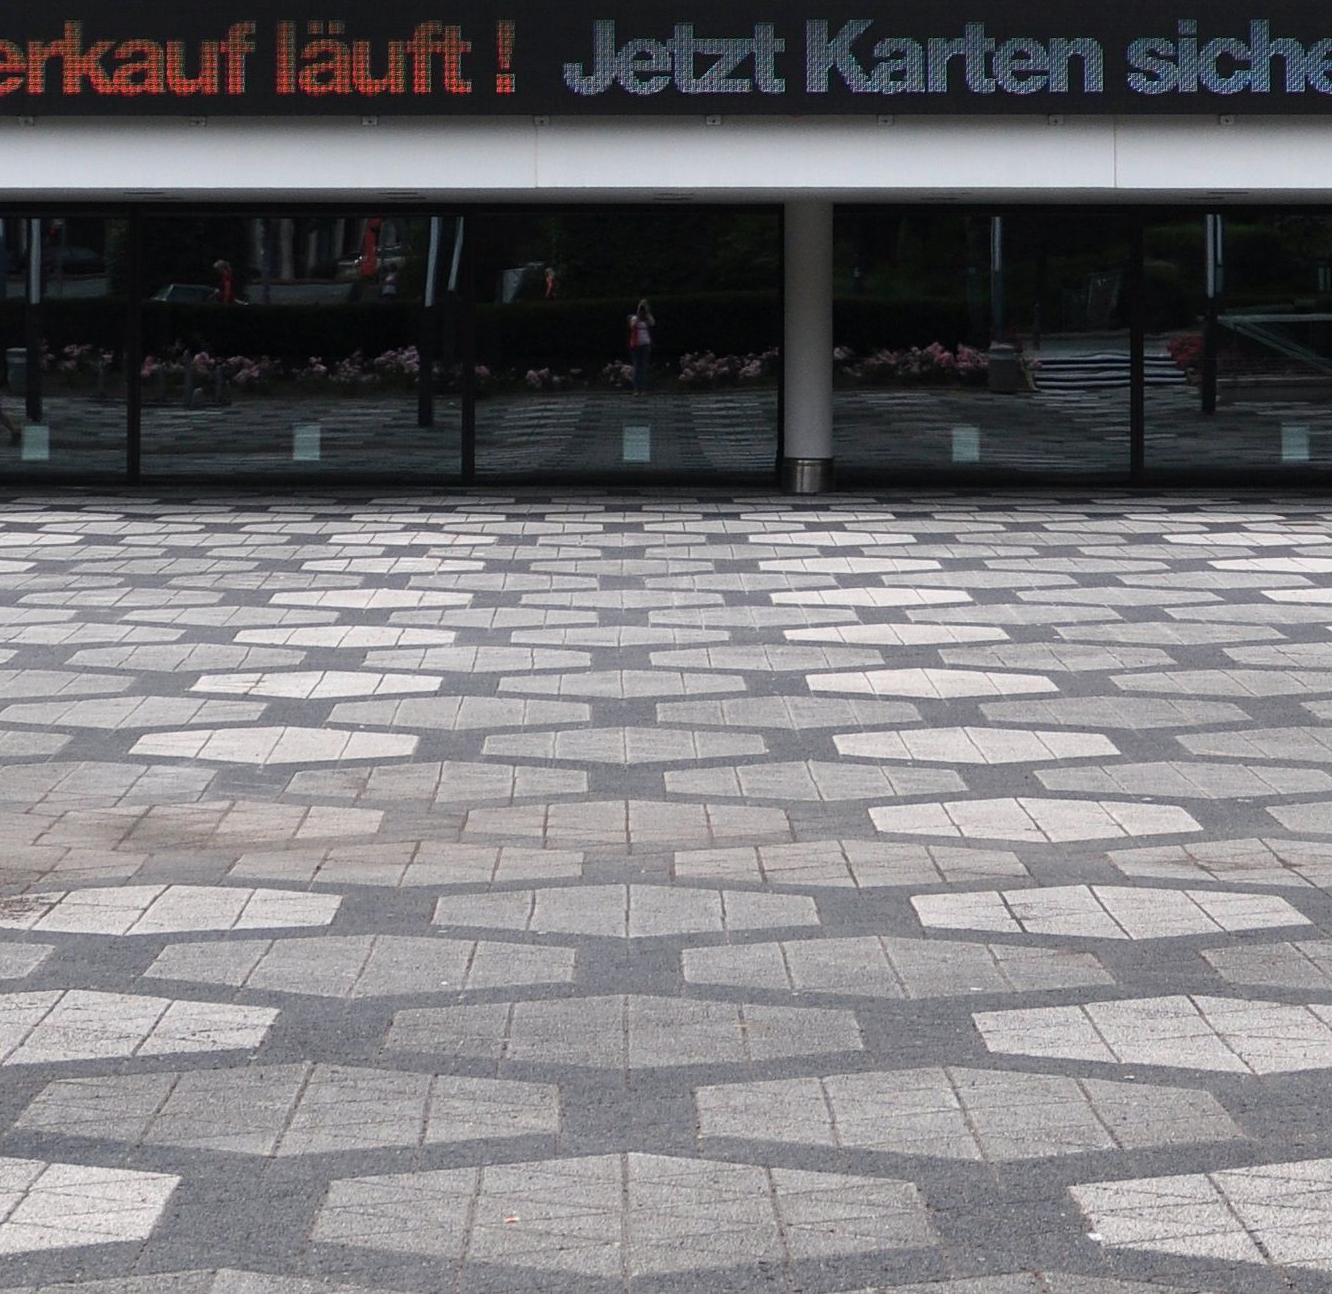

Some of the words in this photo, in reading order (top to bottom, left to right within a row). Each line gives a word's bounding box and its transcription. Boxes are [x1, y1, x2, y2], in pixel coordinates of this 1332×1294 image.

[275, 19, 473, 95] läuft
[562, 19, 787, 96] Jetzt
[805, 19, 1104, 96] Karten
